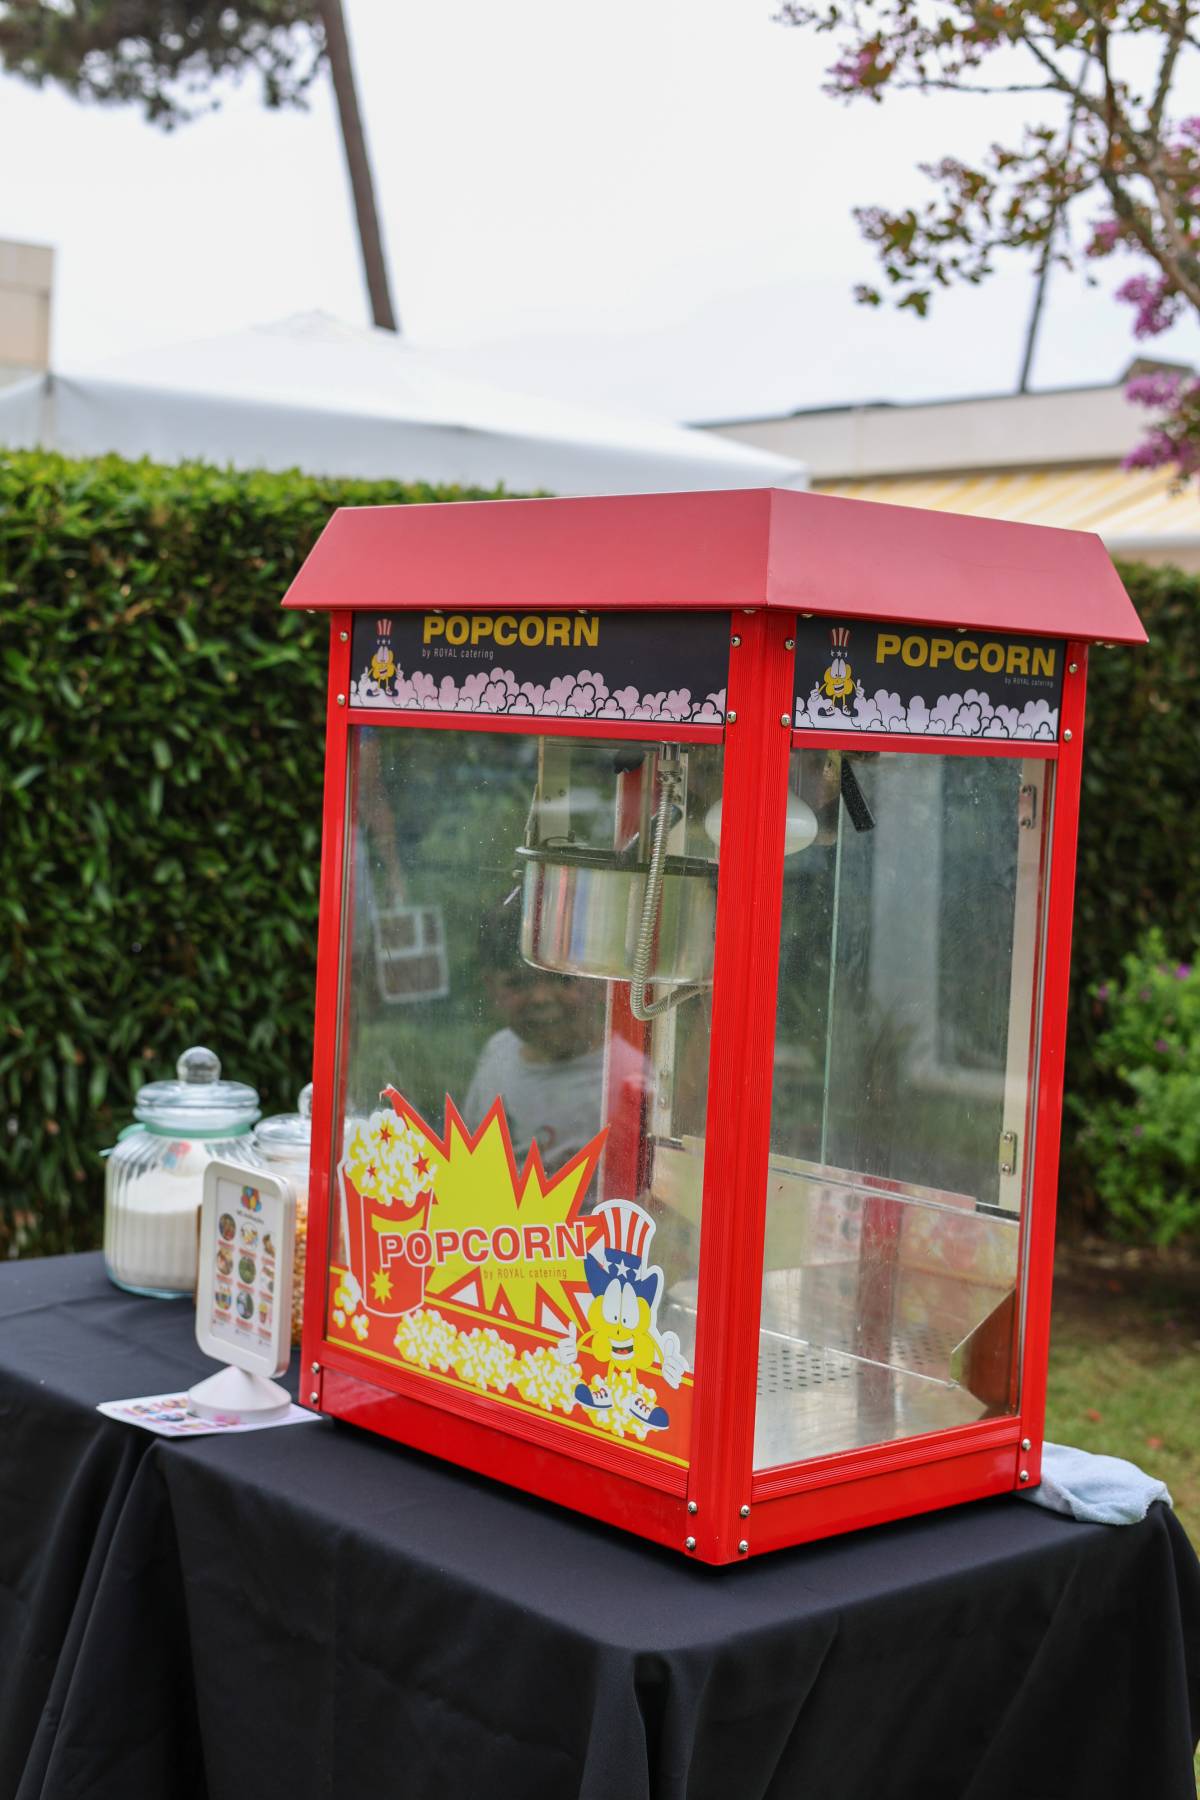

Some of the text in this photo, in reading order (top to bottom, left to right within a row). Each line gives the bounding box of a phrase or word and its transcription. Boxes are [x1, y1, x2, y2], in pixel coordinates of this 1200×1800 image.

[423, 616, 600, 647] POPCORN
[422, 648, 494, 661] by ROYAL catering
[875, 633, 1056, 677] POPCORN
[380, 1222, 586, 1268] POPCORN
[483, 1268, 567, 1280] by ROYAL catering
